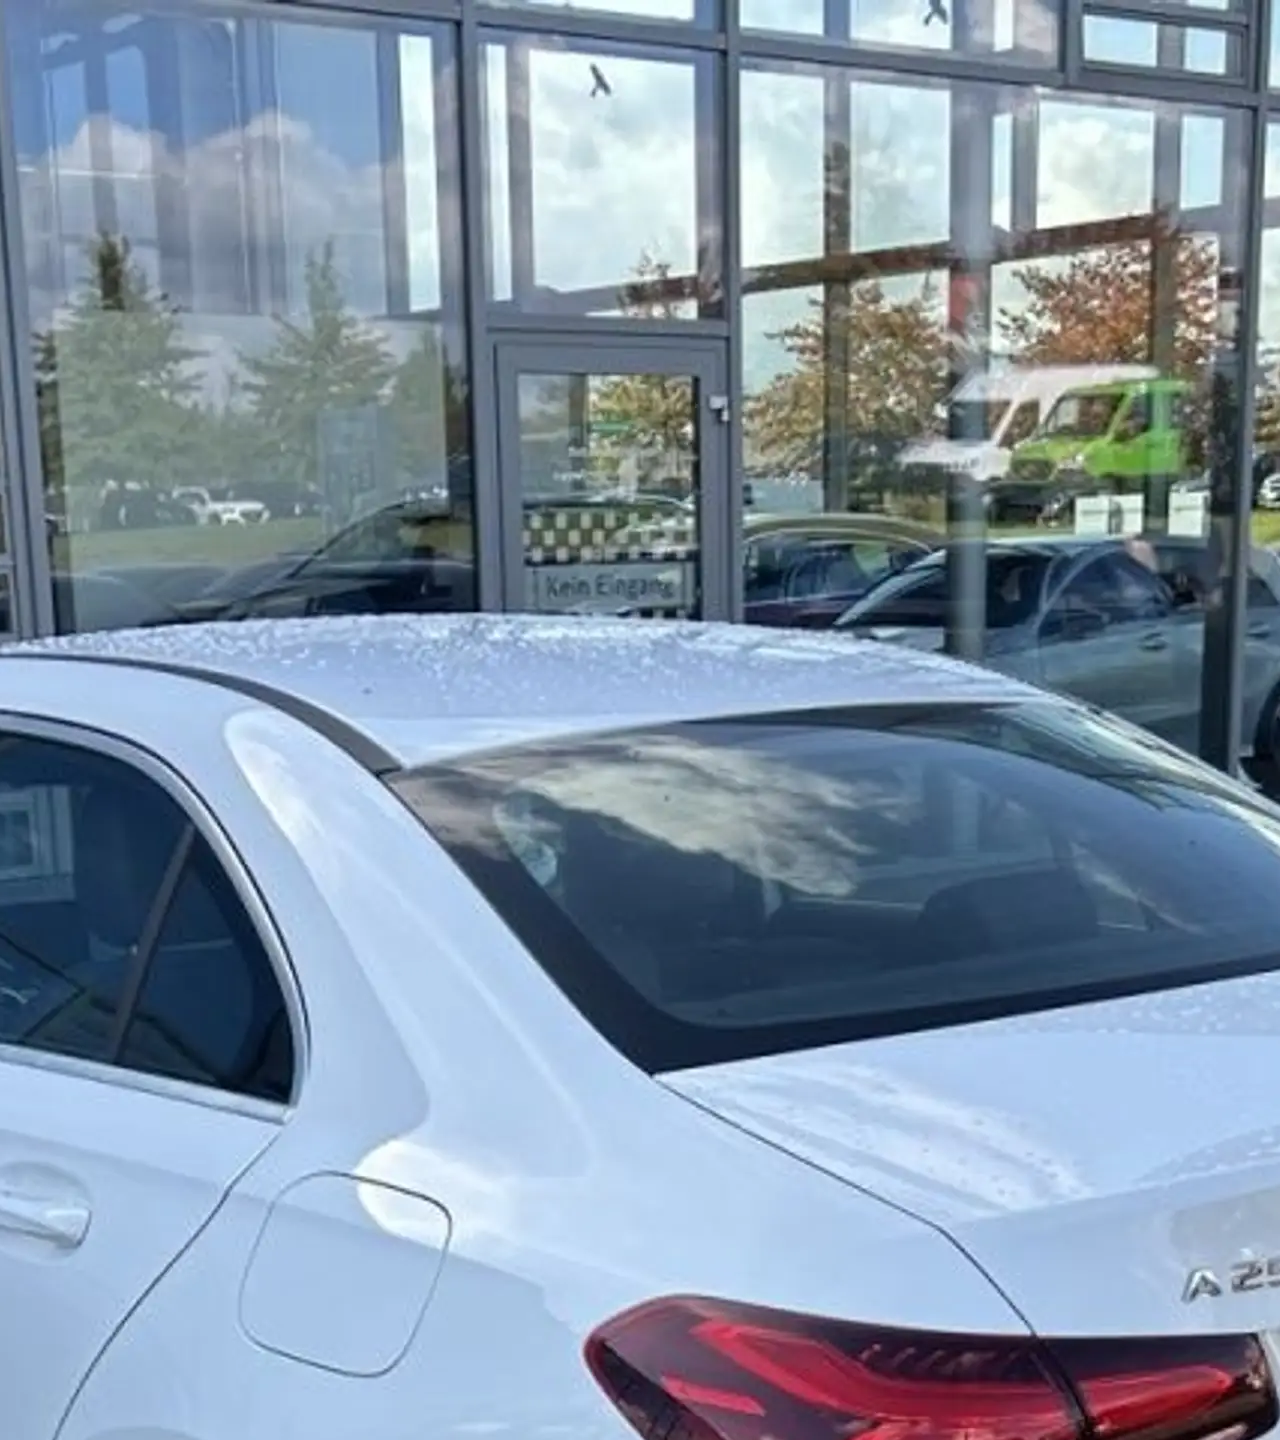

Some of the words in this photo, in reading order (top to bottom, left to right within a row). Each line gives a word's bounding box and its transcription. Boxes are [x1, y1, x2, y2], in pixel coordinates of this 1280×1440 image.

[546, 575, 591, 598] Kein
[595, 574, 674, 600] Eingang
[1181, 1265, 1222, 1304] A
